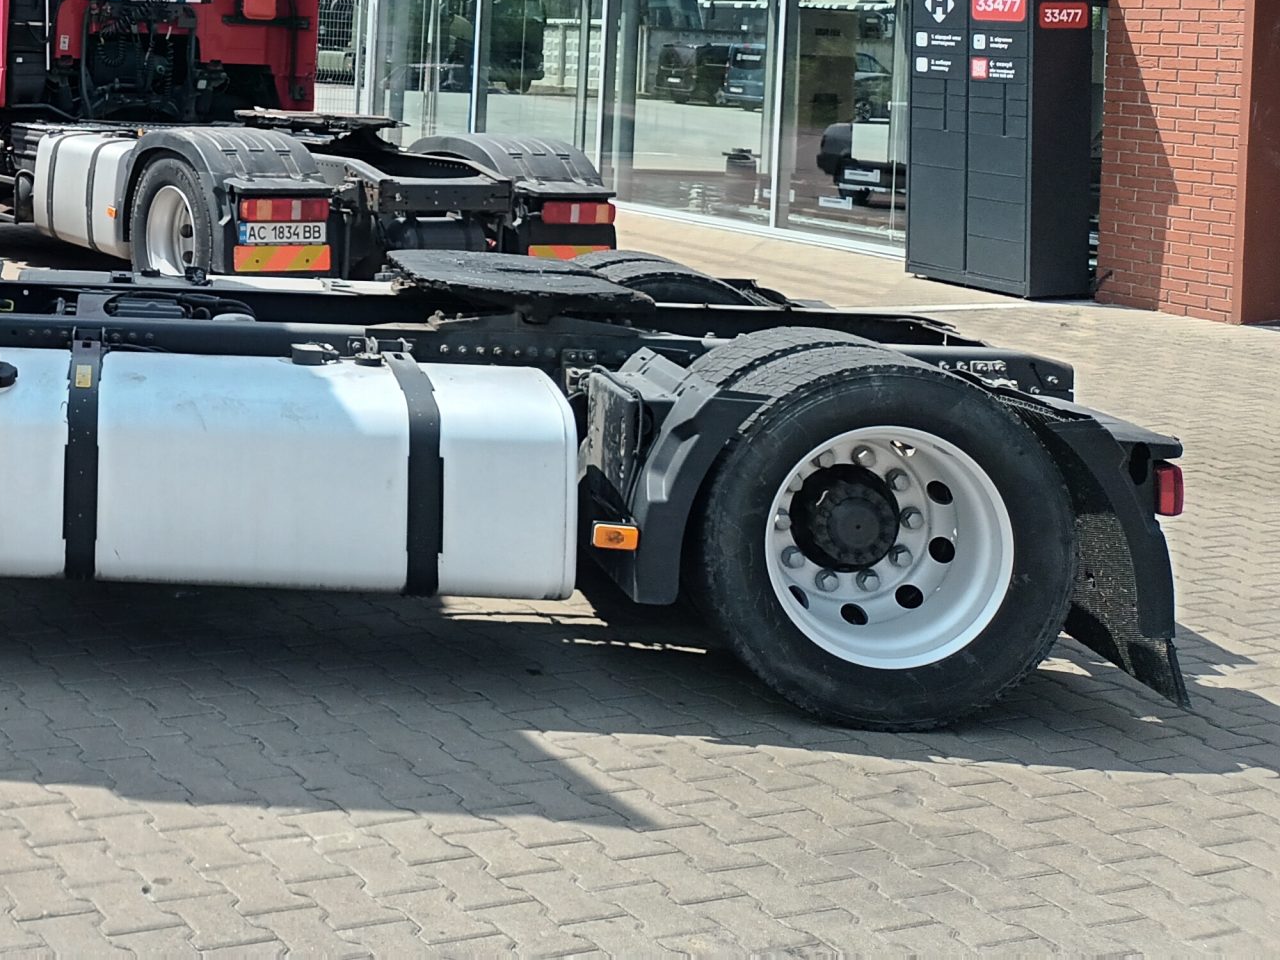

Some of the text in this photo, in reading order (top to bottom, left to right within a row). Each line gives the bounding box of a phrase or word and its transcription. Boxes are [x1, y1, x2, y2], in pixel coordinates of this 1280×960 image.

[1044, 8, 1082, 23] 33477
[248, 225, 322, 240] AC 1834 BB
